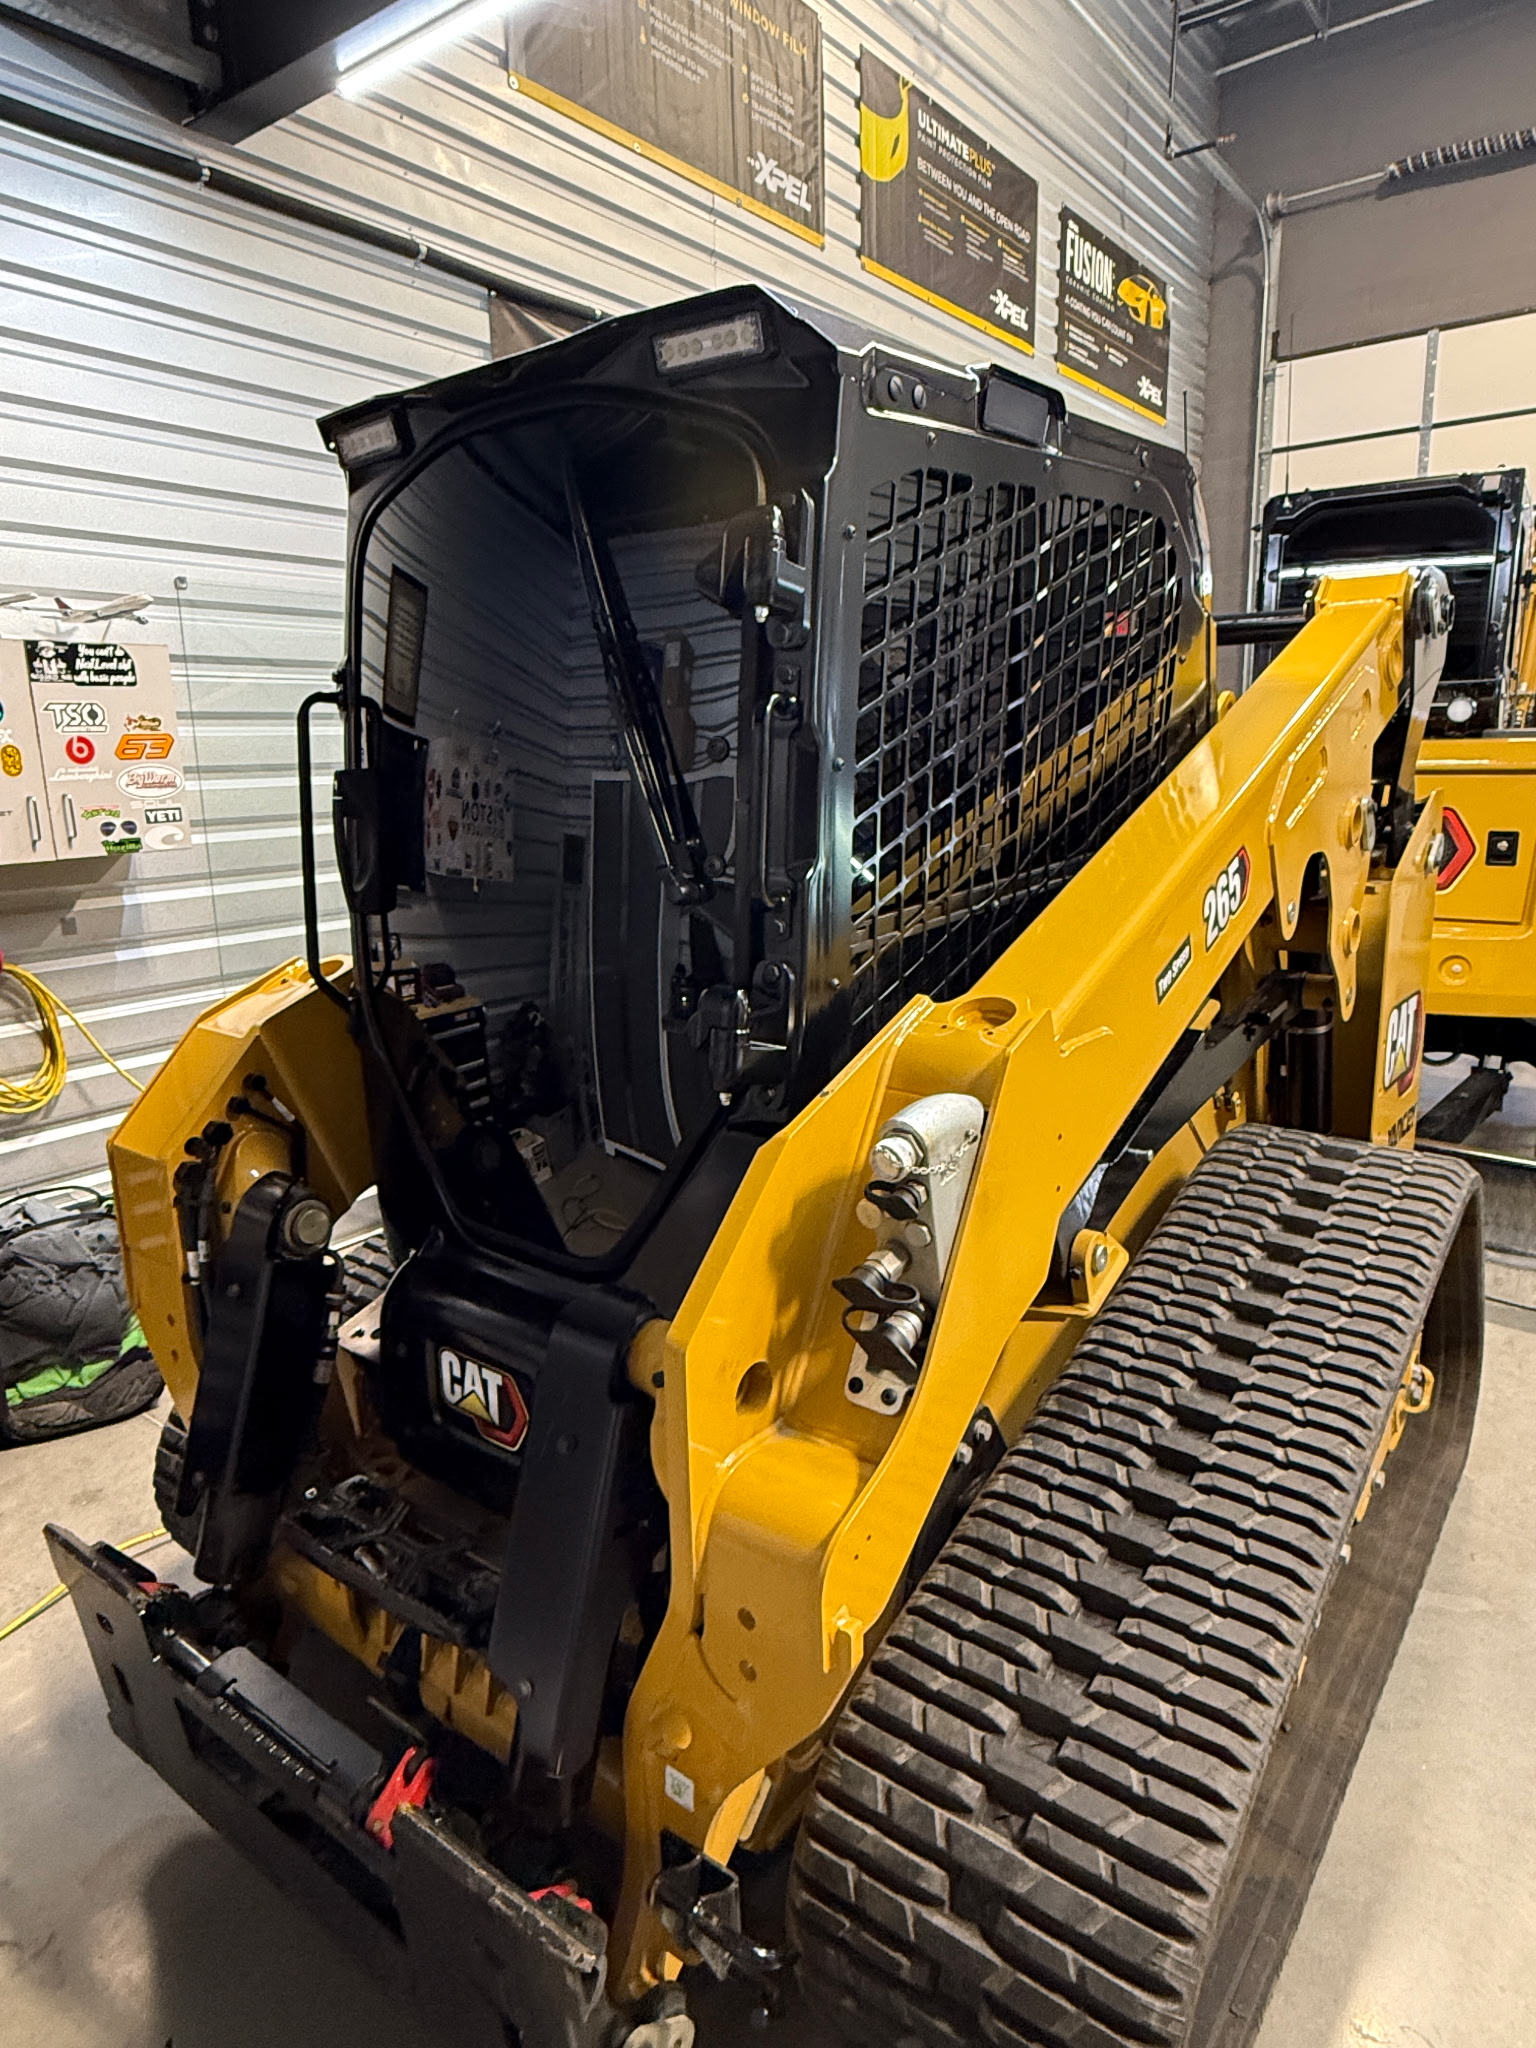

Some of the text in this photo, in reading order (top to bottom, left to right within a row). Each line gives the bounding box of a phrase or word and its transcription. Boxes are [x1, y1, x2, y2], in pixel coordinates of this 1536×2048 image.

[682, 35, 722, 69] TECHNOLOGY
[687, 55, 696, 69] TO
[782, 31, 808, 60] FILM
[917, 130, 992, 191] PAINT PROTECTION FILM
[754, 151, 812, 212] XPEL
[917, 156, 952, 190] BETWEEN
[952, 180, 968, 201] YOU
[968, 190, 984, 212] AND
[983, 201, 996, 221] THE
[996, 210, 1014, 234] OPEN
[1013, 219, 1032, 244] ROAD
[1065, 228, 1113, 300] FUSION
[994, 288, 1028, 331] XPEL
[1065, 275, 1090, 298] CERAMIC
[1092, 291, 1115, 312] COATING
[1064, 294, 1070, 304] A
[1070, 297, 1091, 320] COATING
[1091, 309, 1101, 326] YOU
[1101, 315, 1110, 331] CAN
[1110, 323, 1126, 340] COUNT
[1126, 331, 1134, 345] ON
[1138, 375, 1163, 406] XPEL
[78, 644, 94, 658] You
[114, 645, 125, 656] do
[94, 658, 117, 670] Level
[90, 670, 110, 682] basic
[110, 671, 136, 686] people
[114, 733, 174, 760] 63
[126, 772, 144, 787] Big
[146, 809, 180, 822] YETI
[1204, 856, 1241, 949] 265
[1384, 994, 1419, 1089] CAT
[441, 1350, 502, 1427] CAT
